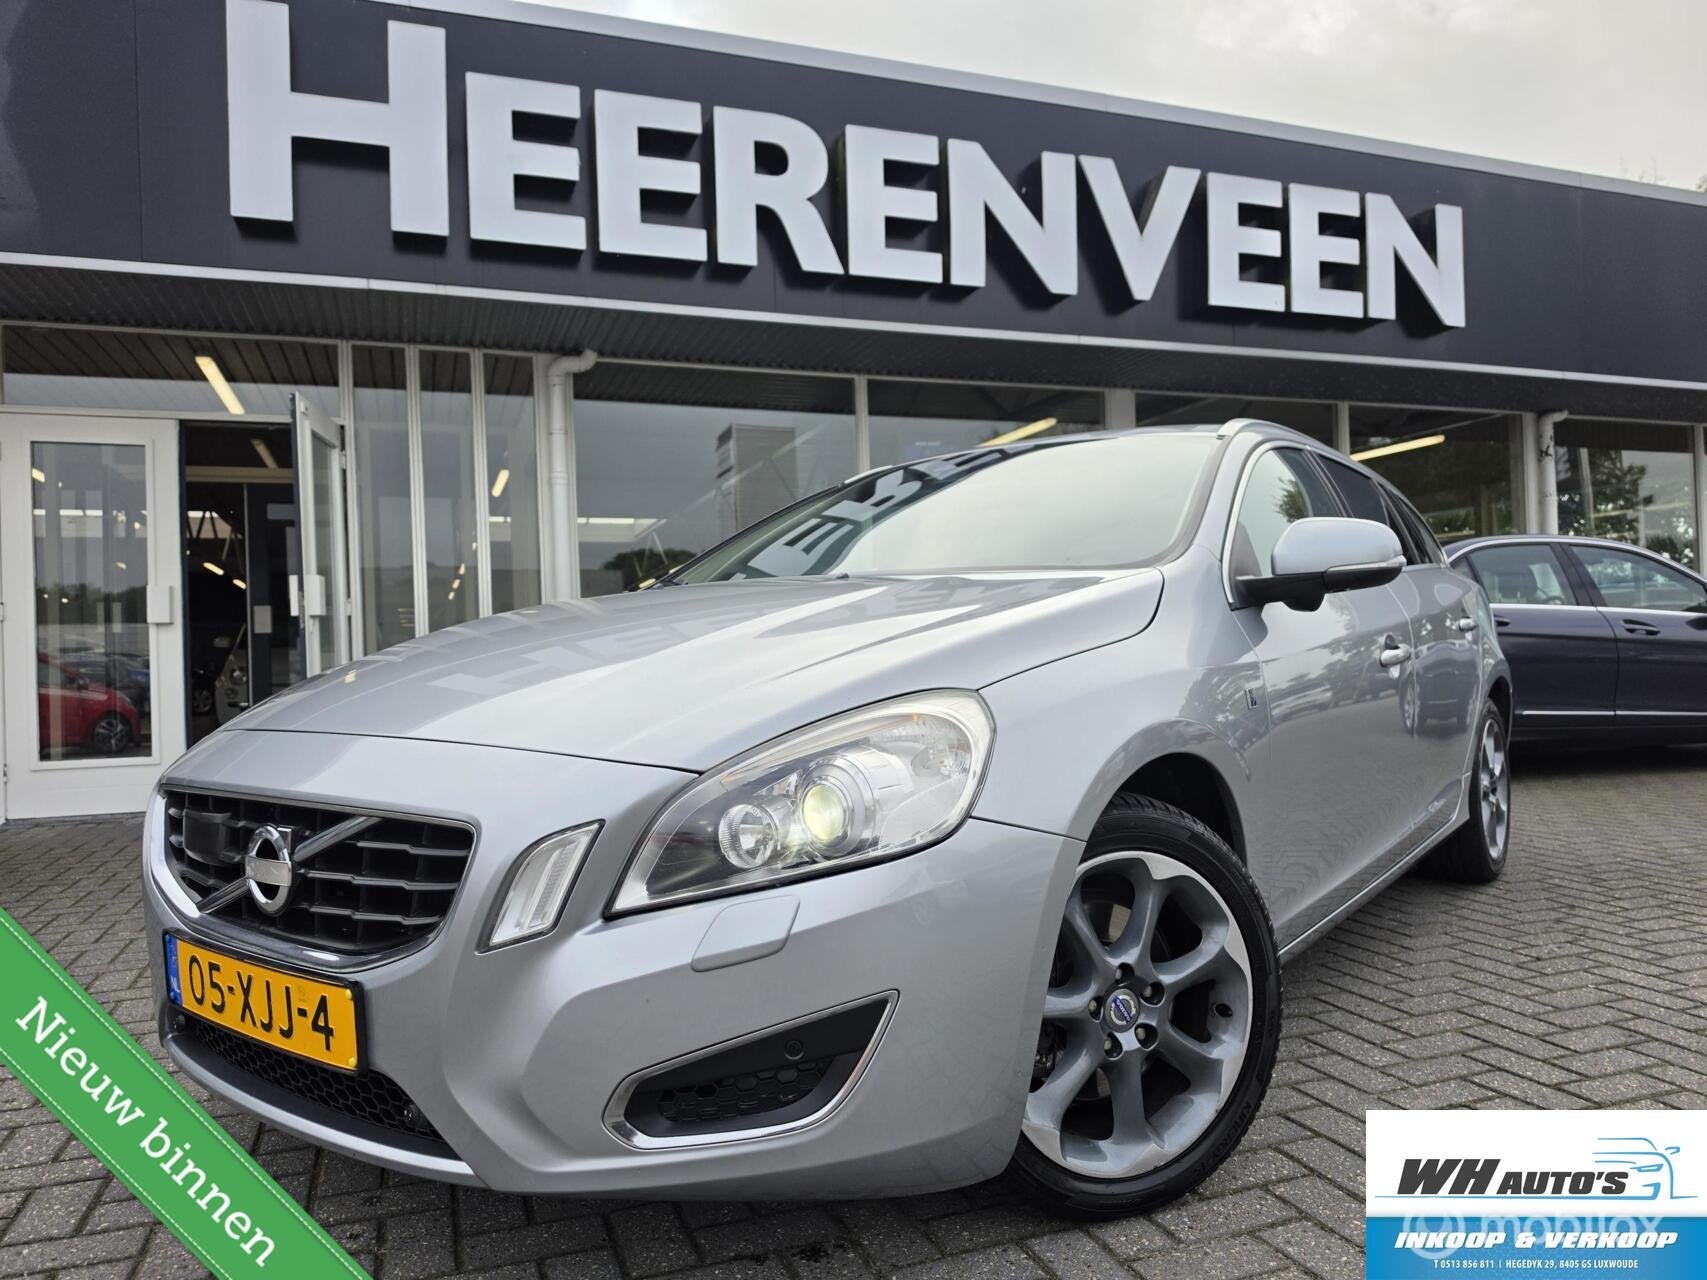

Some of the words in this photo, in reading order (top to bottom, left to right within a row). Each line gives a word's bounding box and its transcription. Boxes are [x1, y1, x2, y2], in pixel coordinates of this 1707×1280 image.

[226, 0, 1466, 328] HEERENVEEN
[170, 975, 181, 993] NL
[188, 954, 335, 1052] 05-XJJ-4
